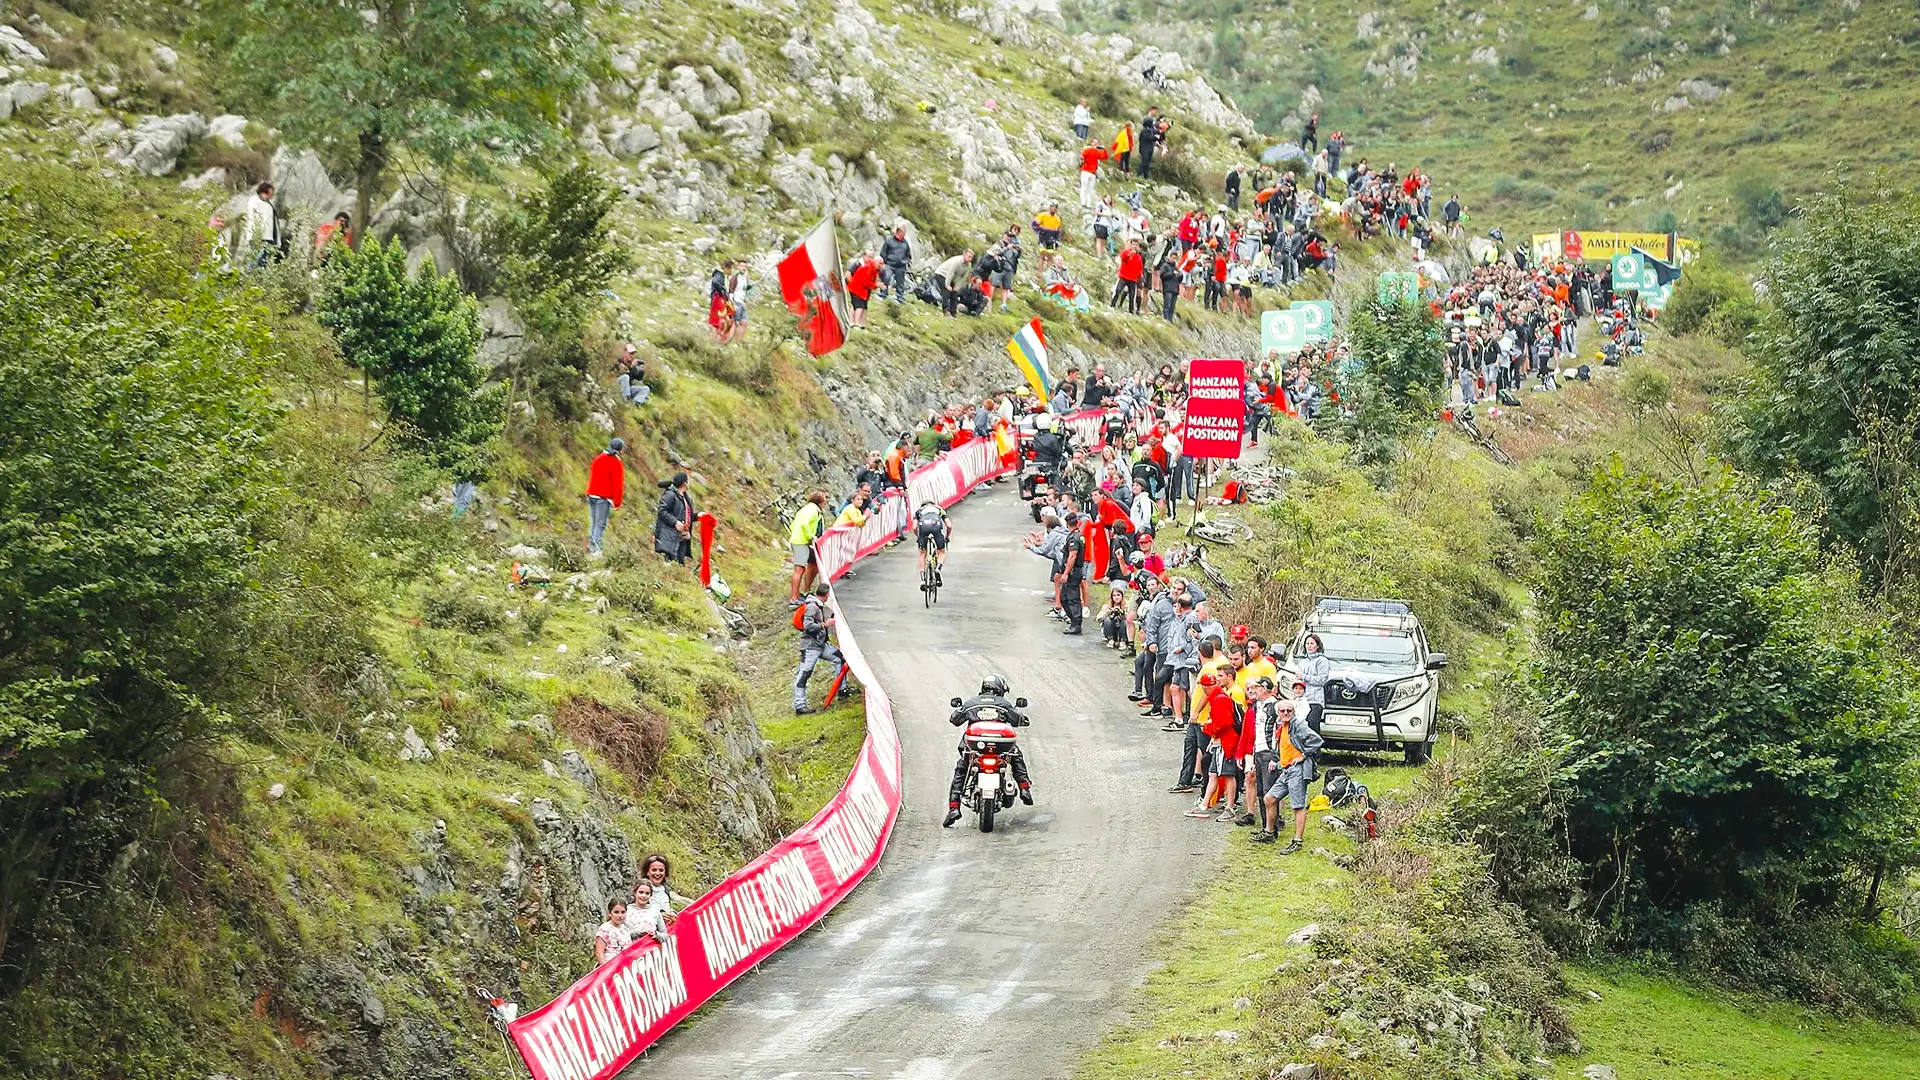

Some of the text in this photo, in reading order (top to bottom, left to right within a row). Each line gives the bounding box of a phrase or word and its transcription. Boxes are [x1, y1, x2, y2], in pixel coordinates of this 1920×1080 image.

[1587, 239, 1630, 249] AMSTEL
[1192, 377, 1239, 387] MANZANA
[1192, 388, 1240, 399] POSTOBON
[1188, 415, 1238, 428] MANZANA
[1187, 428, 1239, 441] POSTOBON
[696, 847, 823, 980] MANZANA POSTOBON
[523, 936, 688, 1080] MANZANA POSTOBON
